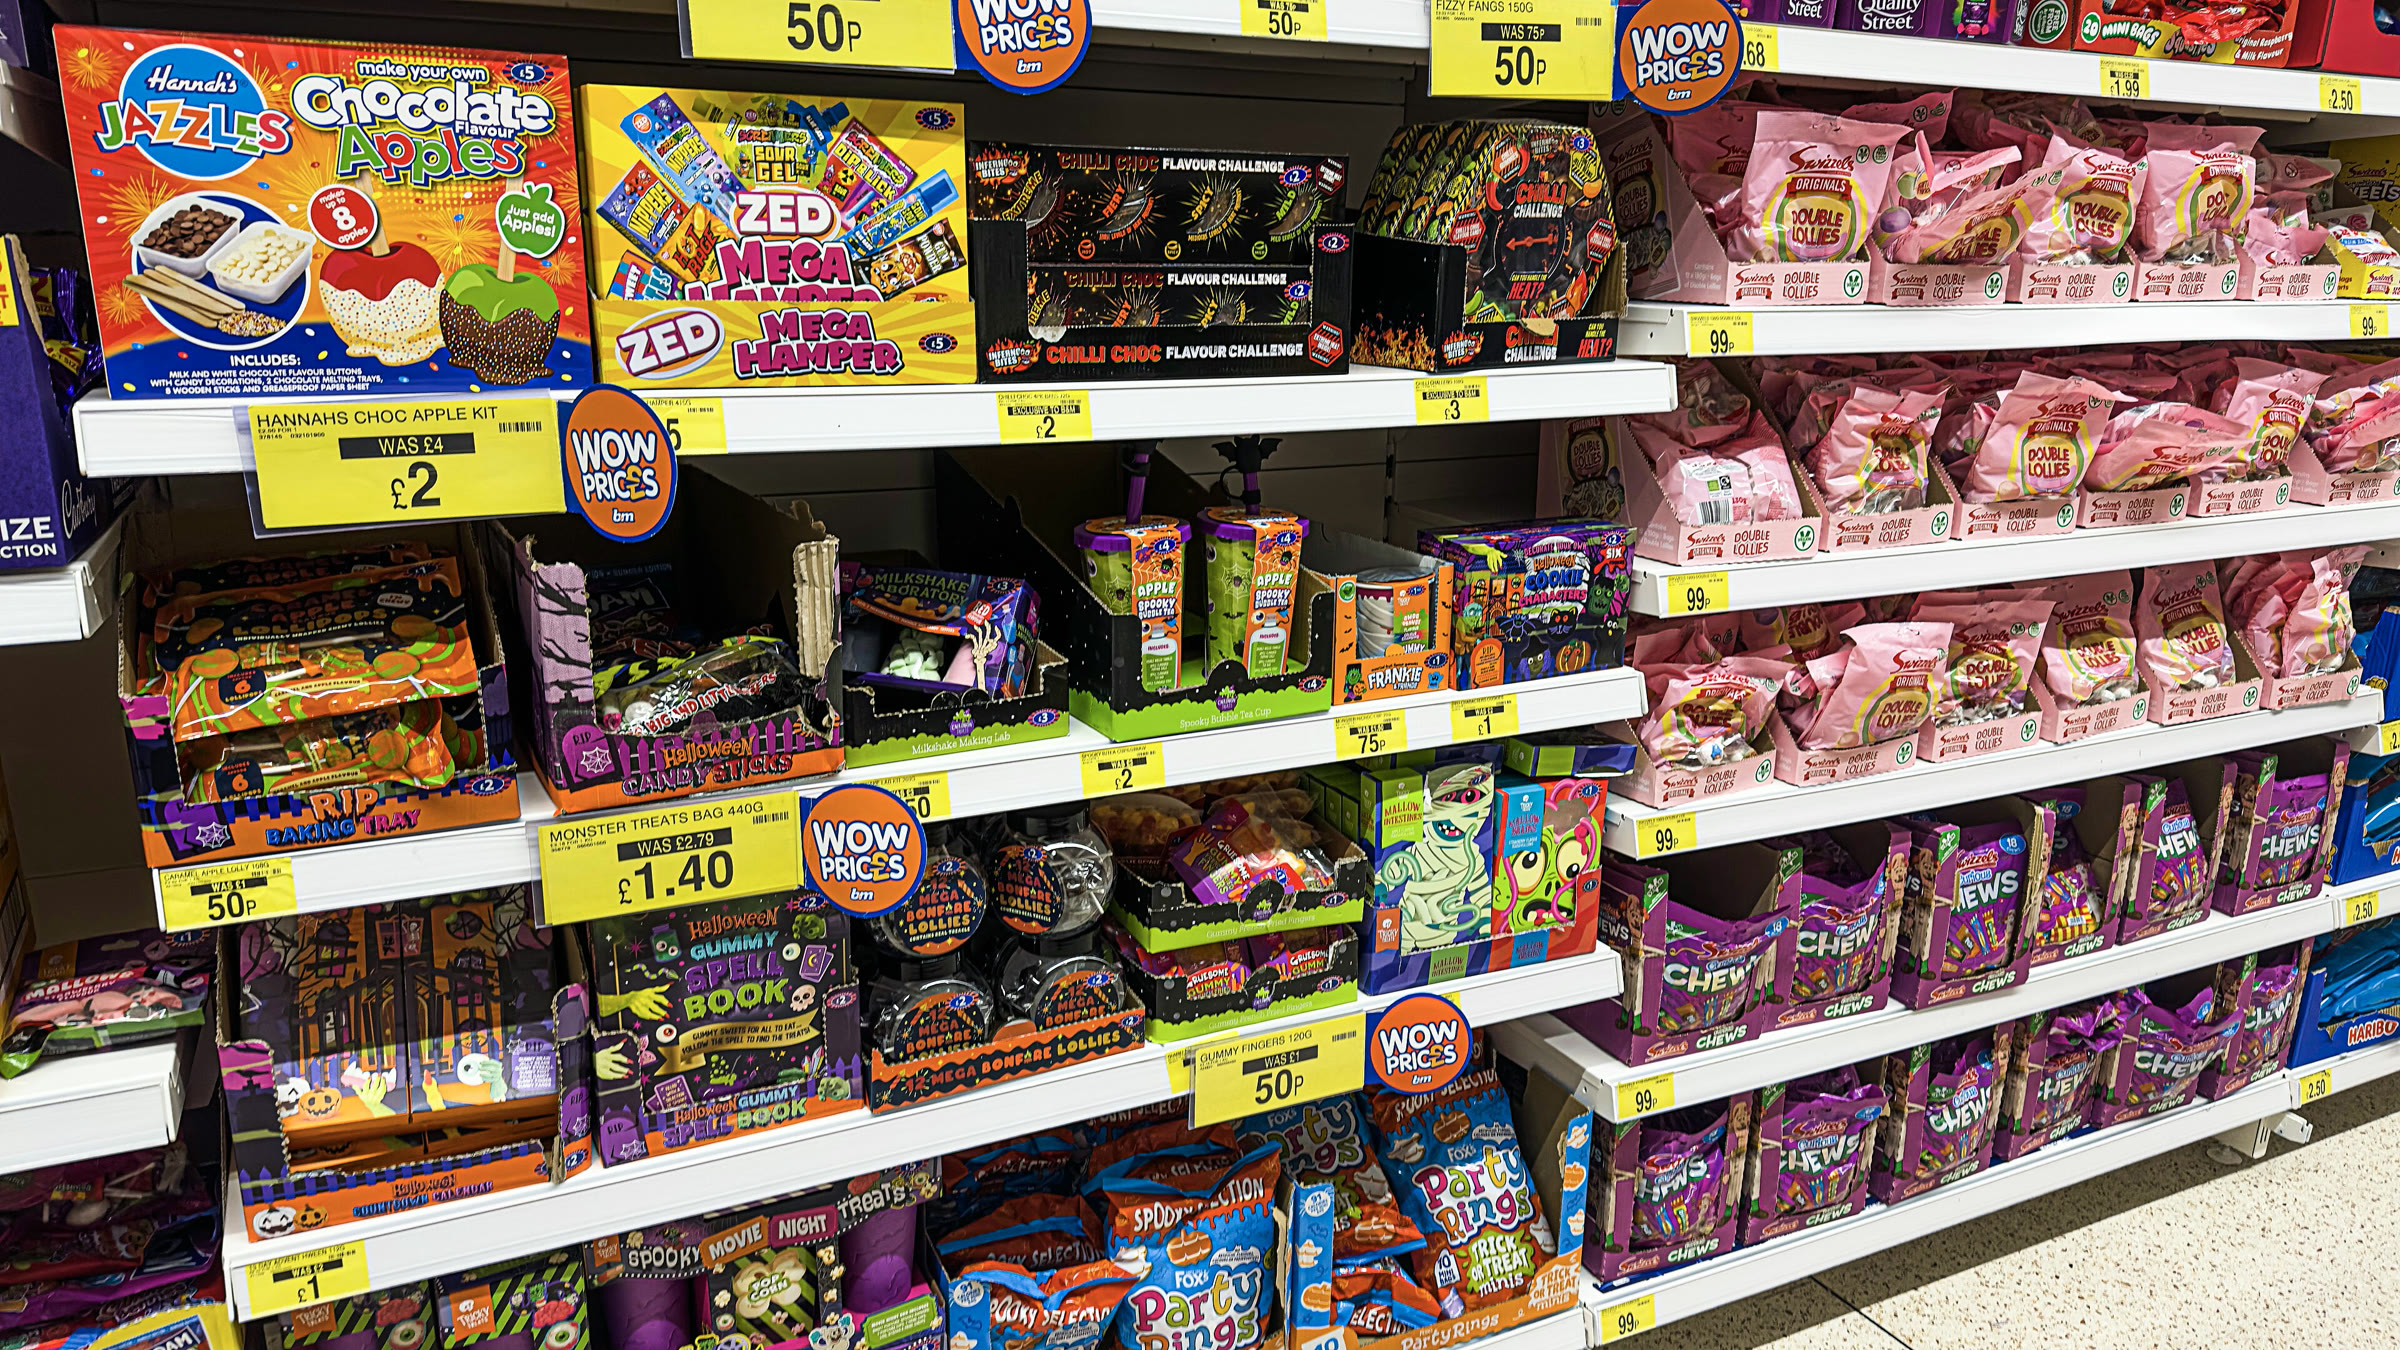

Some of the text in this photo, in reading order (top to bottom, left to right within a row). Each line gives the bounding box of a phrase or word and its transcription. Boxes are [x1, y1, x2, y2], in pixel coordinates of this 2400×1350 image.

[977, 0, 1072, 27] WOW
[1436, 0, 1533, 14] FIZZY FANGS 150G
[1500, 25, 1523, 40] WAS
[1862, 13, 1913, 31] Street
[2083, 20, 2099, 36] 20
[1630, 21, 1728, 64] WOW
[2101, 21, 2130, 39] MINI
[2130, 24, 2161, 47] BAGS
[2259, 31, 2293, 49] Raspberry
[147, 66, 239, 95] Hannah's
[358, 61, 487, 82] make your own
[2110, 79, 2140, 98] £1.99
[2328, 89, 2354, 110] £2.50
[292, 75, 552, 131] Chocolate
[97, 97, 291, 155] JAZZLES
[455, 121, 516, 139] Flavour
[338, 123, 519, 184] Apples
[755, 146, 796, 162] SOUR
[1059, 154, 1285, 173] CHILLI CHOC FLAVOUR CHALLENGE
[1785, 145, 1855, 175] Swizzels
[755, 162, 796, 182] GEL
[1795, 177, 1847, 194] ORIGINALS
[507, 205, 555, 224] Just add
[737, 193, 834, 236] ZED
[1513, 203, 1565, 219] CHALLENGE
[1791, 209, 1844, 229] DOUBLE
[502, 216, 556, 238] Apples!
[1791, 227, 1841, 247] LOLLIES
[1508, 280, 1545, 300] HEAT?
[1783, 272, 1820, 286] DOUBLE
[1782, 285, 1819, 300] LOLLIES
[759, 311, 871, 341] MEGA
[230, 354, 301, 367] INCLUDES:
[735, 340, 902, 374] HAMPER
[1046, 343, 1304, 364] CHILLI CHOC FLAVOUR CHALLENGE
[150, 375, 384, 388] WITH CANDY DECORATIONS, 2 CHOCOLATE MELTING TRAYS,
[169, 368, 363, 379] MILK AND WHITE CHOCOLATE FLAVOUR BUTTONS
[165, 382, 370, 395] 8 WOODEN STICKS AND GREASEPROOF PAPER SHEET
[257, 405, 498, 428] HANNAHS CHOC APPLE KIT
[1444, 399, 1461, 420] £3
[1036, 415, 1056, 439] £2
[378, 437, 444, 455] WAS £4
[571, 429, 658, 470] WOW
[390, 461, 441, 511] £2
[62, 479, 97, 540] Cadbury
[1734, 530, 1770, 545] DOUBLE
[1606, 548, 1623, 560] SIX
[1733, 542, 1769, 556] LOLLIES
[875, 573, 969, 593] MILKSHAKE
[1137, 582, 1176, 598] APPLE
[1525, 569, 1585, 590] COOKIE
[1137, 597, 1176, 613] SPOOKY
[1892, 650, 1939, 673] Swizzels
[1367, 666, 1423, 690] FRANKIE
[1180, 708, 1272, 729] Spooky Bubble Tea Cup
[1478, 715, 1492, 736] £1
[664, 736, 756, 769] Halloween
[912, 732, 1011, 754] Milkshake Making Lab
[622, 752, 793, 796] CANDY STICKS
[1115, 769, 1133, 790] £2
[310, 788, 380, 823] RIP
[266, 809, 421, 847] BAKING TRAY
[549, 801, 764, 843] MONSTER TREATS BAG 440G
[637, 832, 715, 856] WAS £2.79
[812, 820, 911, 858] WOW
[618, 849, 735, 906] £1.40
[687, 906, 780, 941] Halloween
[2353, 904, 2373, 921] £2.50
[690, 930, 780, 961] GUMMY
[683, 978, 789, 1022] BOOK
[1379, 1020, 1458, 1051] WOW
[1696, 1025, 1747, 1050] CHEWS
[2347, 1020, 2398, 1046] HARIBO
[1200, 1030, 1313, 1063] GUMMY FINGERS 120G
[905, 1076, 927, 1094] 12
[931, 1065, 977, 1086] MEGA
[1057, 1029, 1121, 1056] LOLLIES
[1264, 1052, 1300, 1069] WAS £1
[2306, 1081, 2326, 1100] £2.50
[1416, 1146, 1525, 1209] Party
[1437, 1187, 1534, 1242] Rings
[709, 1214, 827, 1261] MOVIE NIGHT
[1471, 1229, 1518, 1261] TRICK
[628, 1246, 701, 1269] SPOOKY
[1668, 1239, 1720, 1263] CHEWS
[1472, 1248, 1529, 1282] OR TREAT
[1478, 1272, 1524, 1299] minis
